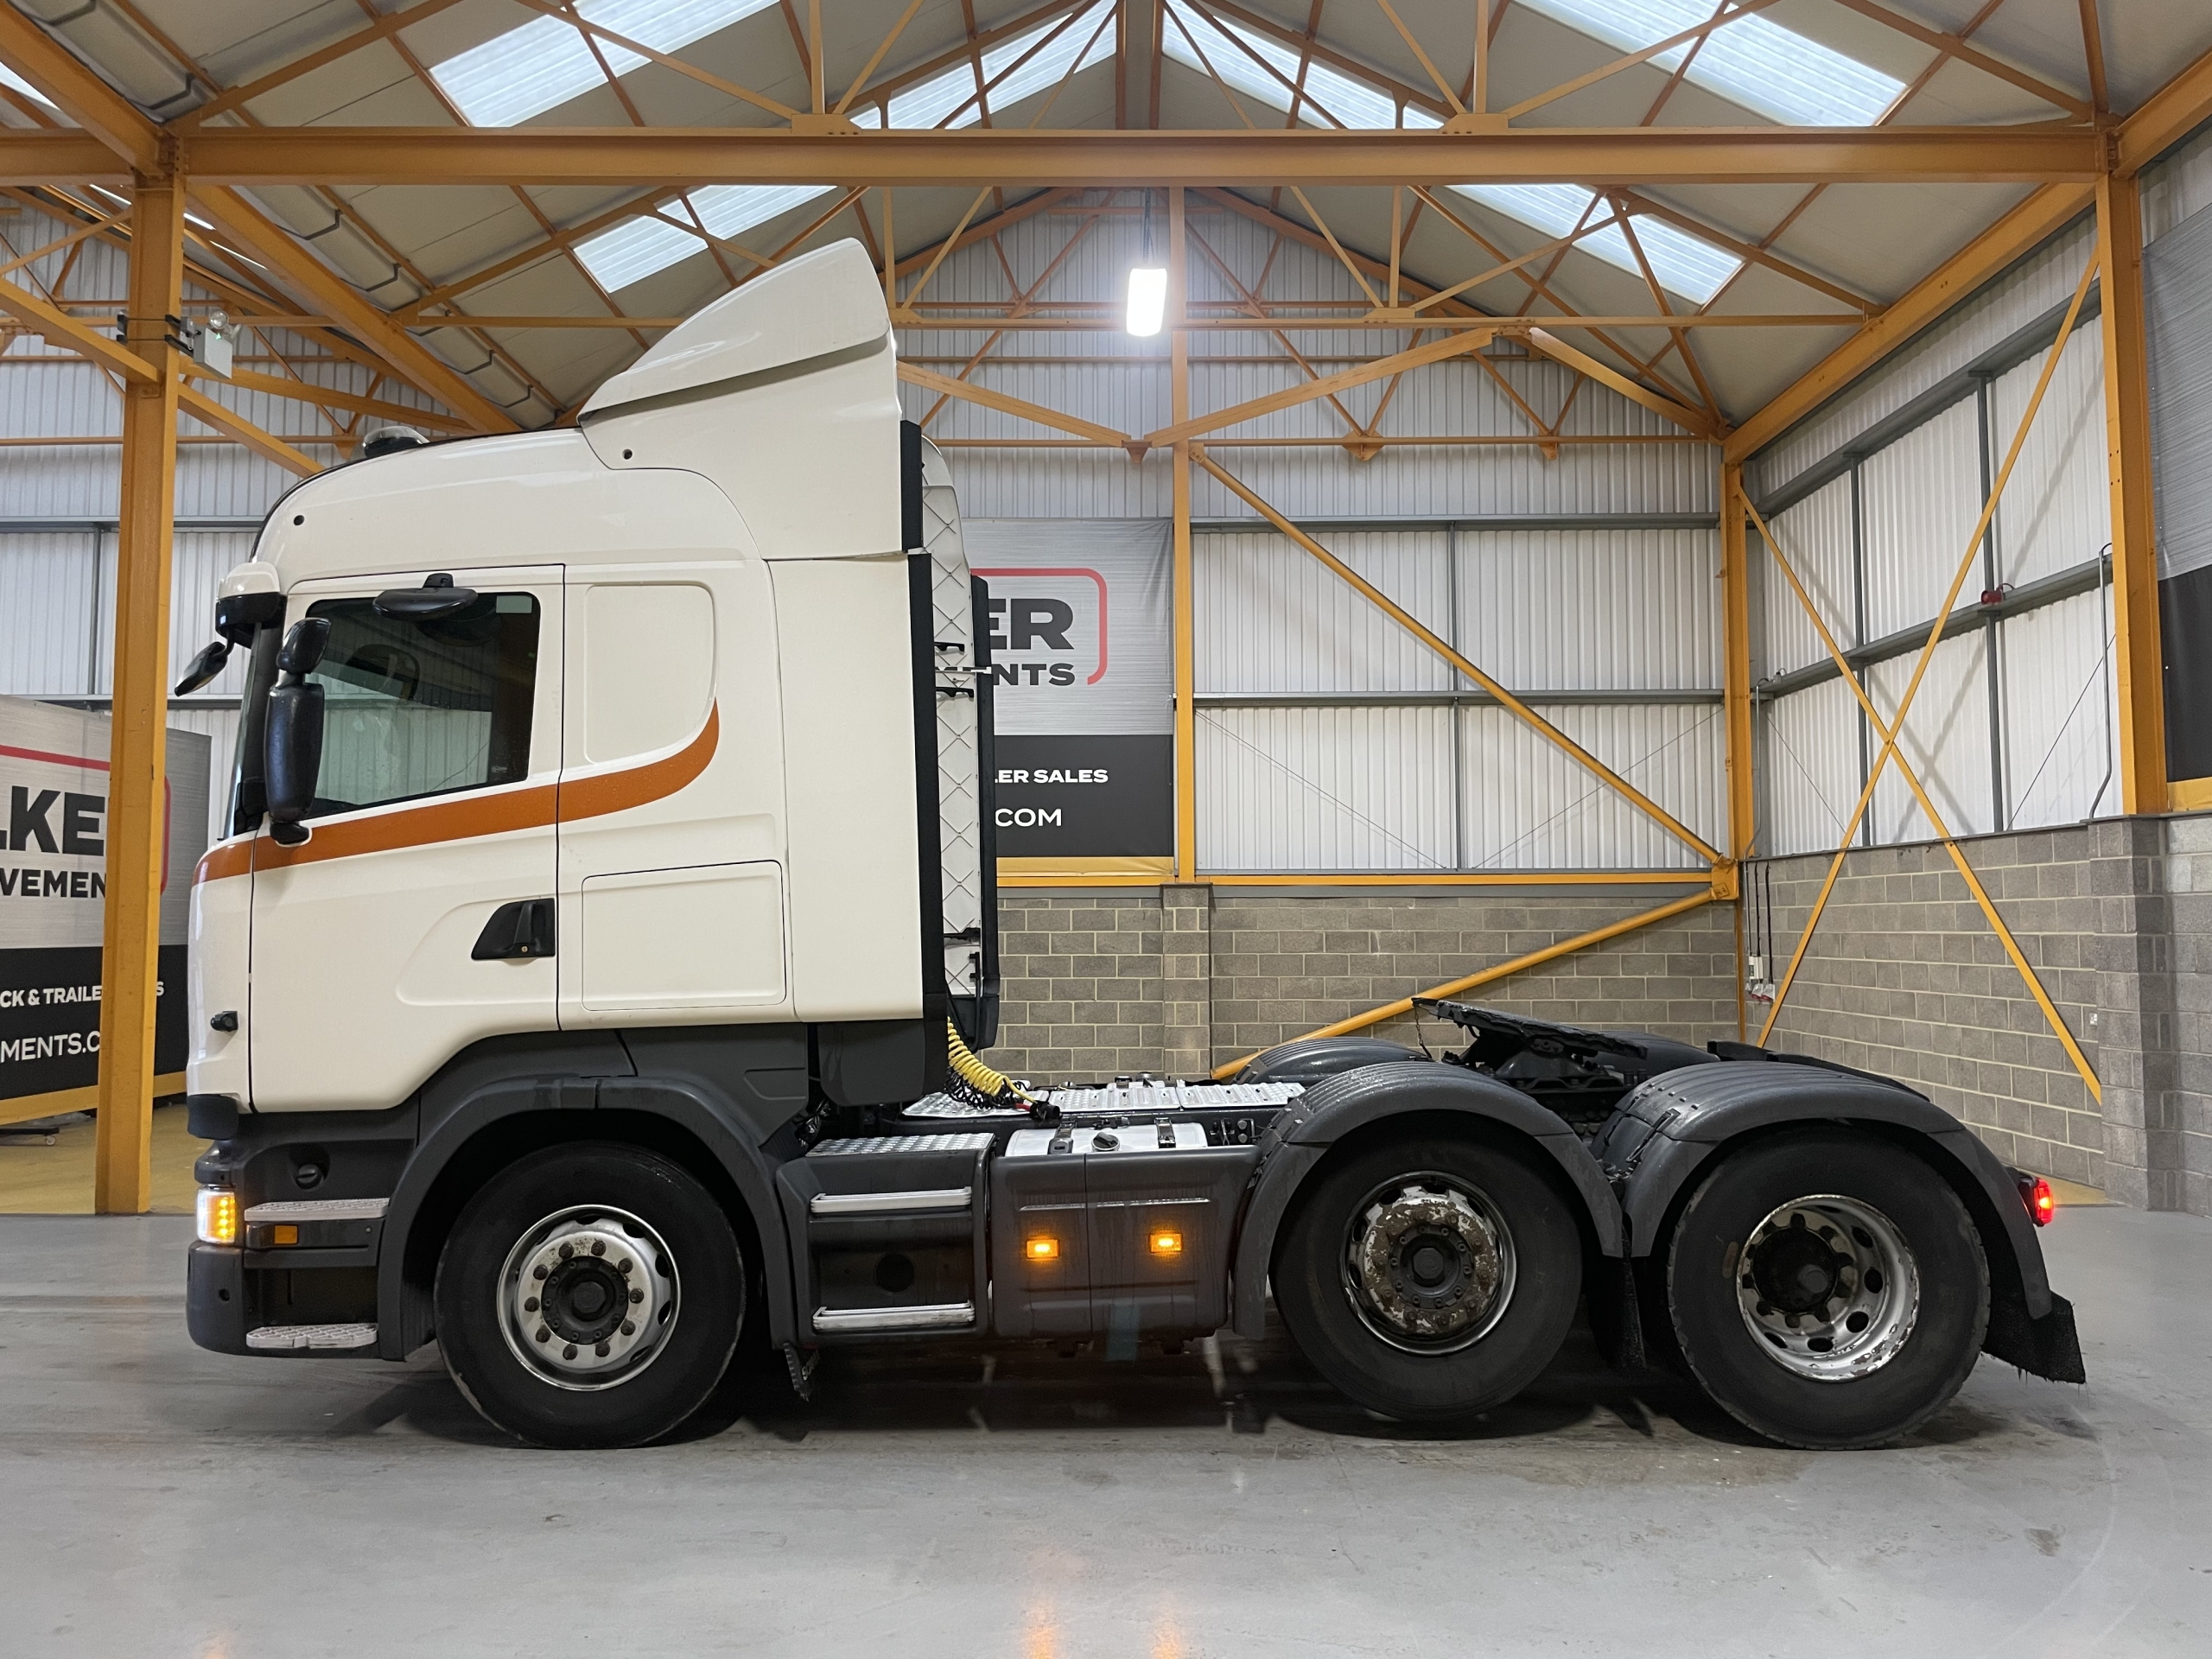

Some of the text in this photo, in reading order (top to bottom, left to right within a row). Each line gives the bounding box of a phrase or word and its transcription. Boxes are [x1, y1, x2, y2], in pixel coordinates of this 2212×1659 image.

[995, 769, 1109, 784] ER SALES
[0, 785, 105, 856] KE
[995, 808, 1062, 827] COM
[0, 985, 103, 1007] CK & TRAILE
[0, 1031, 101, 1063] MENTS.C
